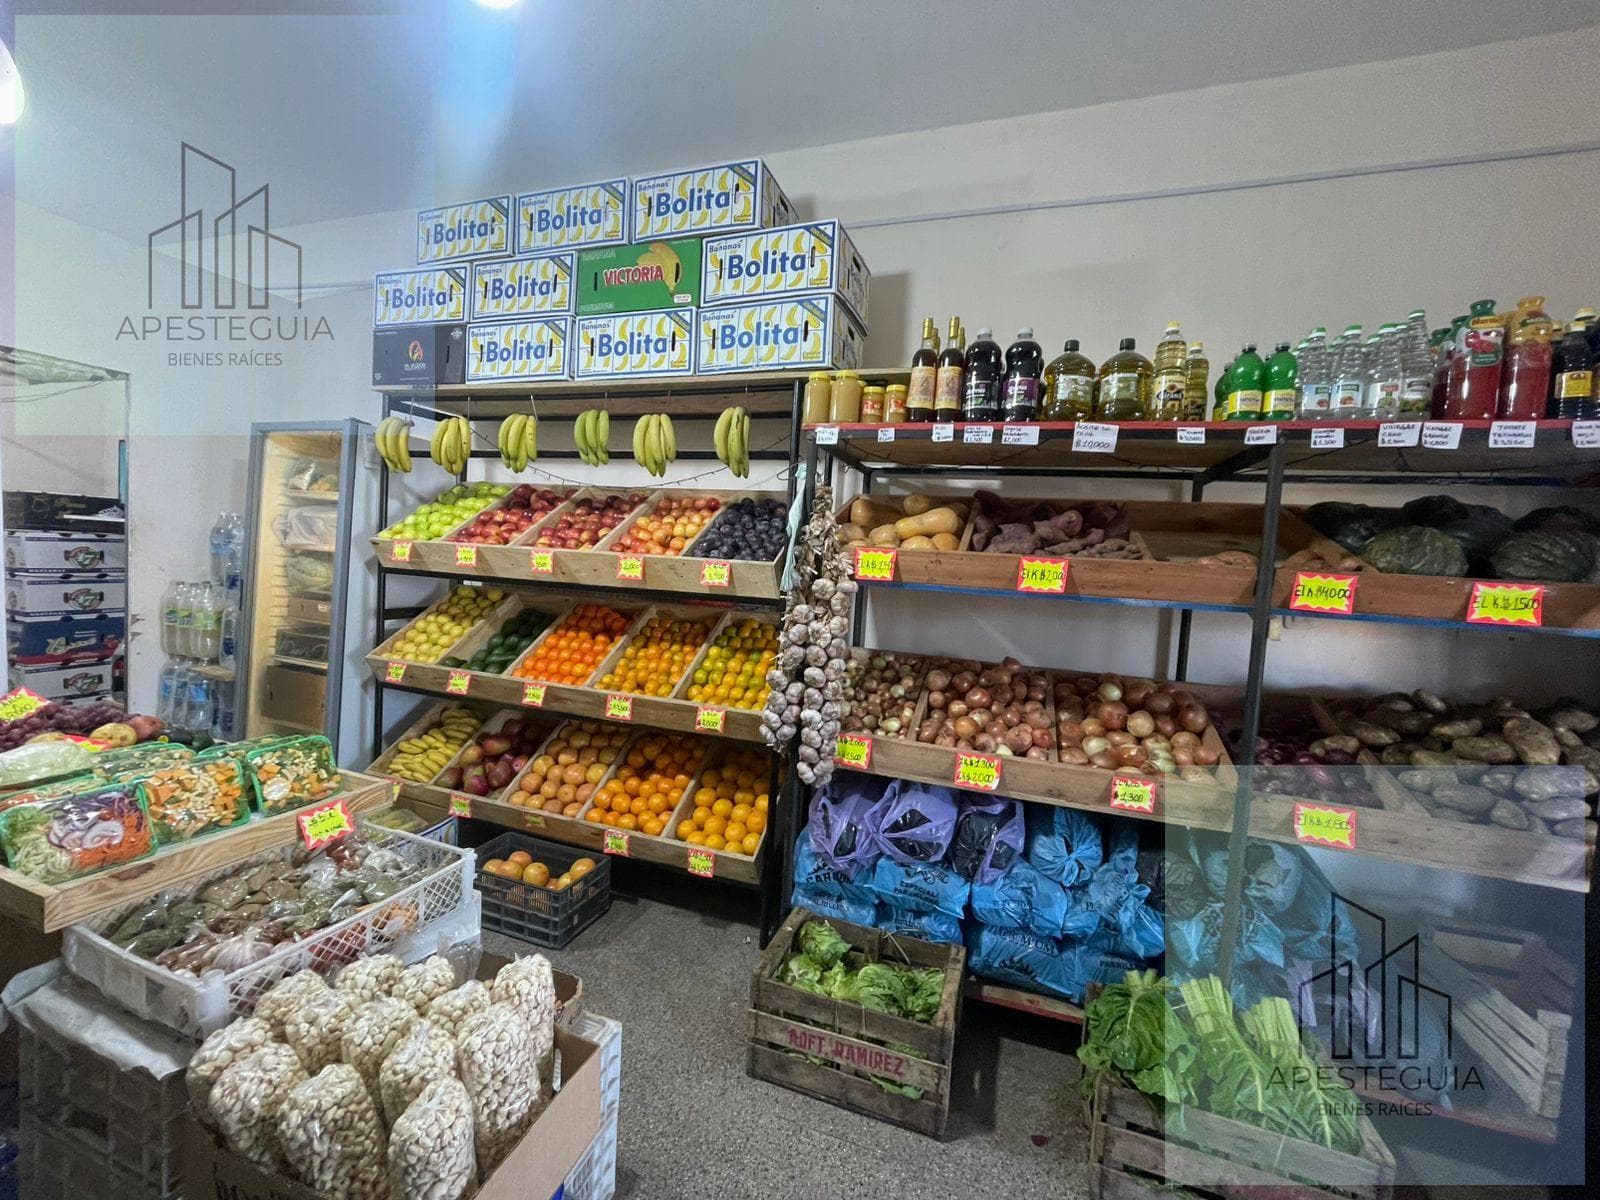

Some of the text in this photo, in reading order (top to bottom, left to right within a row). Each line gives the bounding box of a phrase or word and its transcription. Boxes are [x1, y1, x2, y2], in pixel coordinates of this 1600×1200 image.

[656, 187, 730, 217] Bolita
[537, 205, 602, 232] Bolita
[433, 219, 488, 244] Bolita
[709, 243, 741, 253] Bananas
[603, 264, 665, 288] VICTORIA
[728, 249, 806, 280] Bolita
[392, 286, 447, 309] Bolita
[491, 275, 550, 300] Bolita
[581, 321, 611, 331] Bananas
[702, 313, 735, 322] Bananas
[598, 332, 667, 357] Bolita
[720, 321, 799, 350] Bolita
[486, 337, 546, 363] Bolita
[834, 1041, 905, 1077] RAMIREZ
